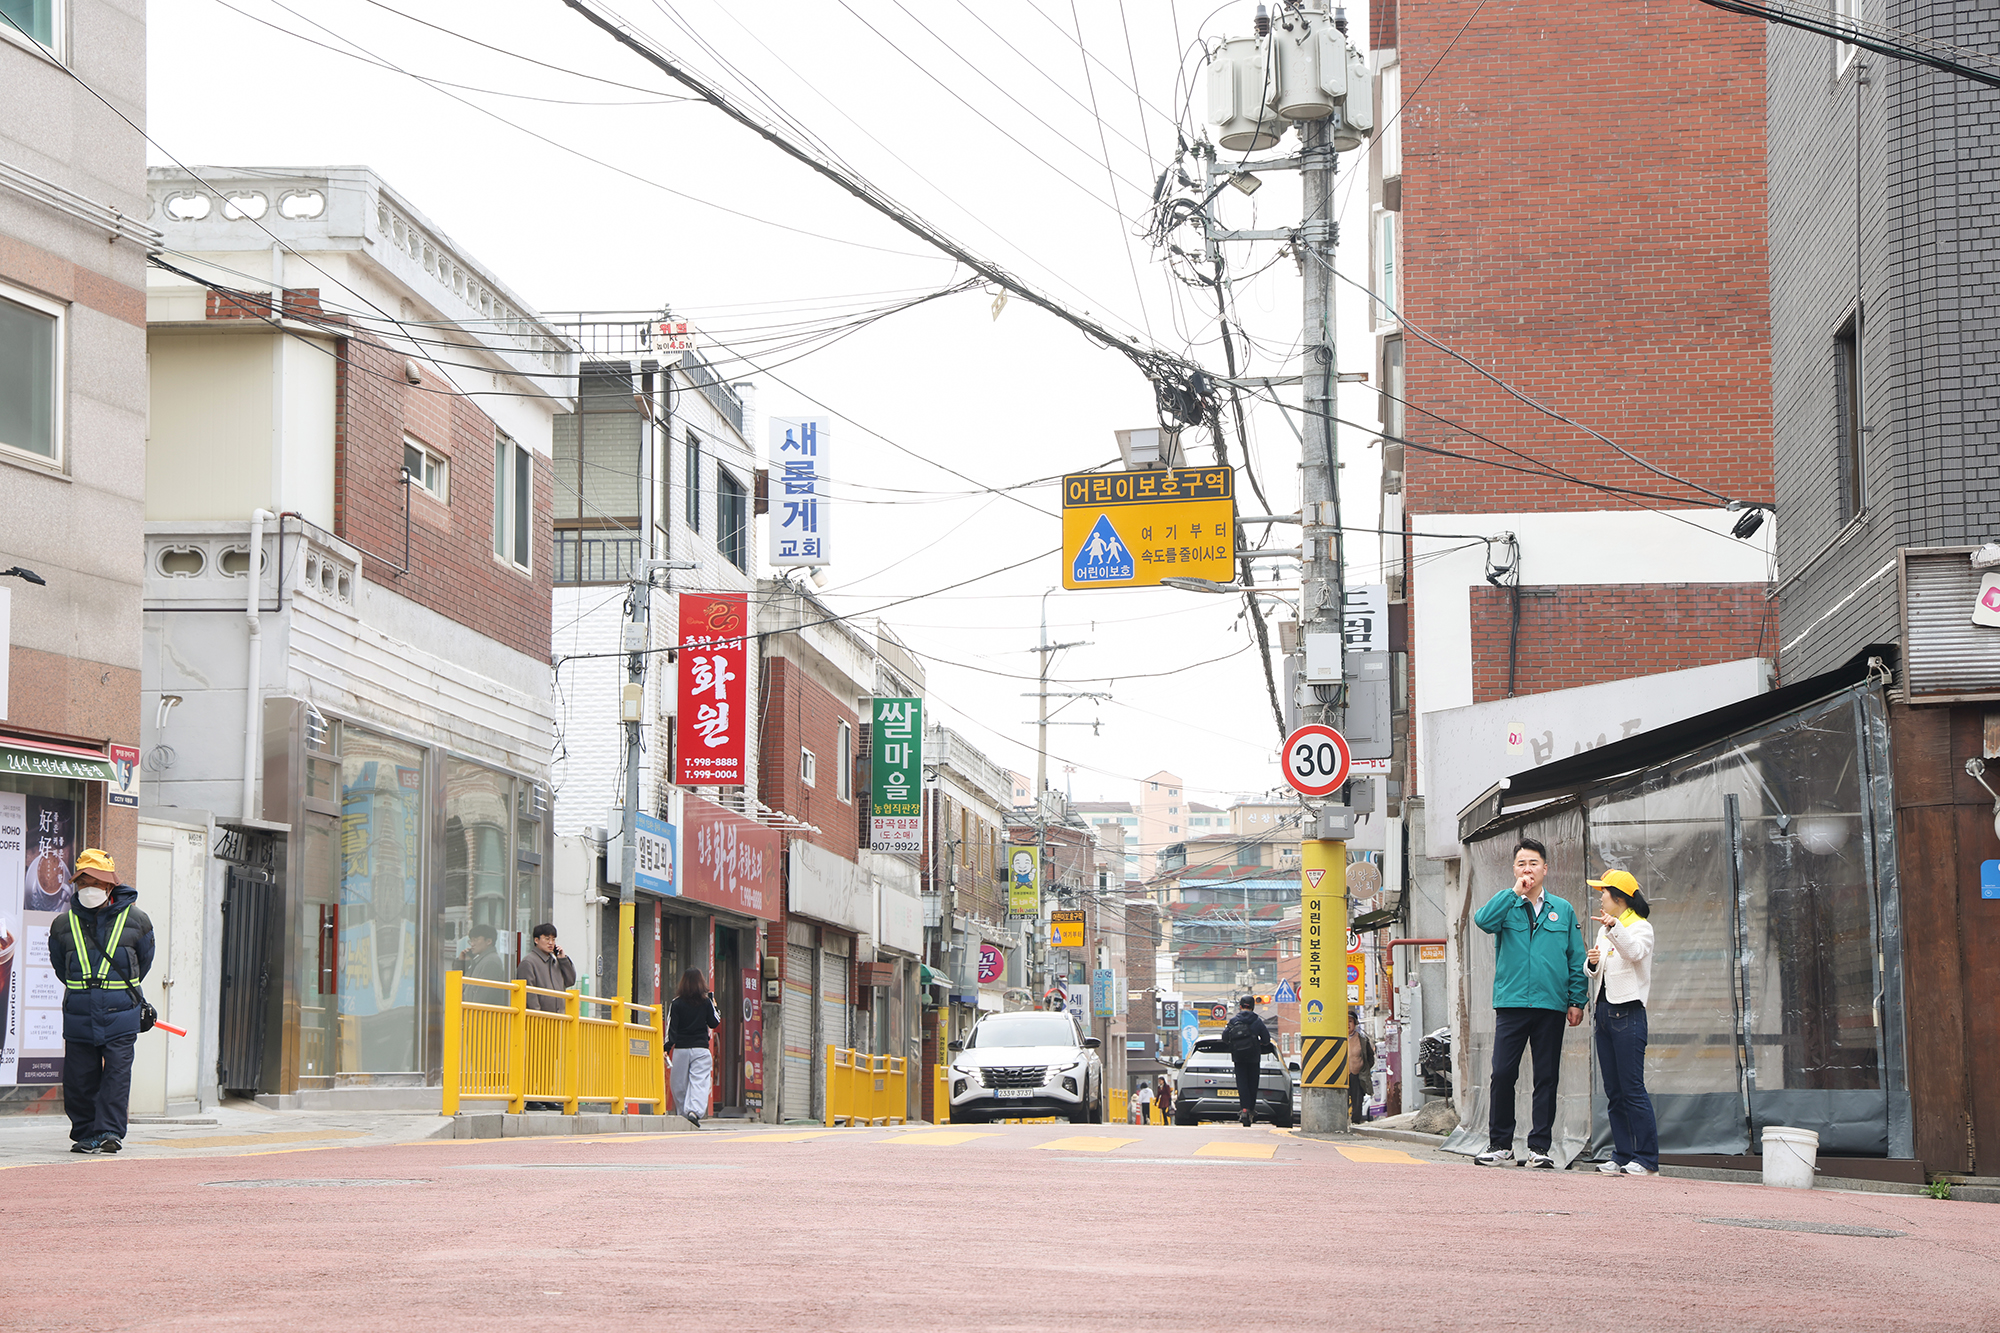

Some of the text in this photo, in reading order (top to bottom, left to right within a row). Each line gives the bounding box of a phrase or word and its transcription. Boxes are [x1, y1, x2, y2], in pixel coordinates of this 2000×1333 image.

[780, 422, 818, 532] 새롭게
[1069, 471, 1225, 502] 어린이보호구역
[779, 538, 820, 558] 교회
[1141, 545, 1228, 564] 속도를 줄이시오
[1077, 564, 1131, 579] 어린이보호
[683, 635, 742, 651] 중화요리
[691, 654, 736, 748] 화원
[878, 702, 918, 800] 쌀마을
[685, 757, 738, 767] T.998-8888
[1295, 742, 1336, 777] 30
[685, 769, 738, 779] T.999-0004
[874, 803, 920, 815] 농협직판장
[2, 825, 21, 836] HOHO
[874, 819, 918, 830] 잡곡일절
[871, 842, 920, 851] 907-9922
[639, 836, 667, 876] 엘림교회
[713, 821, 737, 894] 화원
[738, 842, 763, 884] 중화요리
[1354, 880, 1374, 891] 상회
[1310, 900, 1320, 988] 어린이보호구역
[1164, 1003, 1176, 1011] GS
[1214, 1008, 1224, 1017] 30
